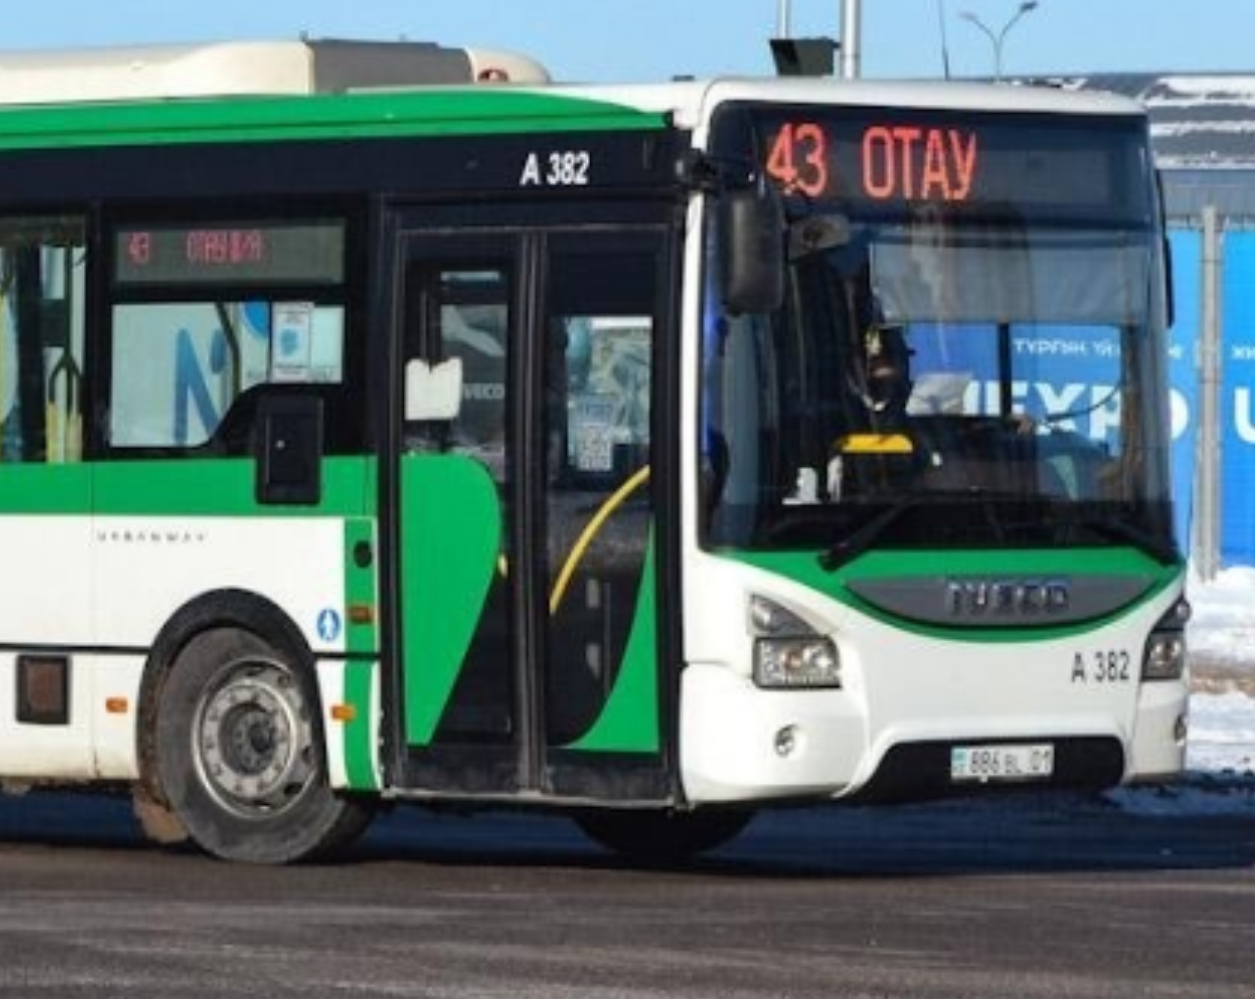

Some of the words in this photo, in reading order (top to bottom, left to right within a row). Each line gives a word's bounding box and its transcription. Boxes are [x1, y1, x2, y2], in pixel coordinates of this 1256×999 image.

[519, 153, 540, 185] A
[546, 151, 590, 185] 382
[766, 123, 827, 197] 43
[862, 126, 976, 200] ОТАУ
[1071, 652, 1086, 683] A
[1095, 651, 1130, 682] 382
